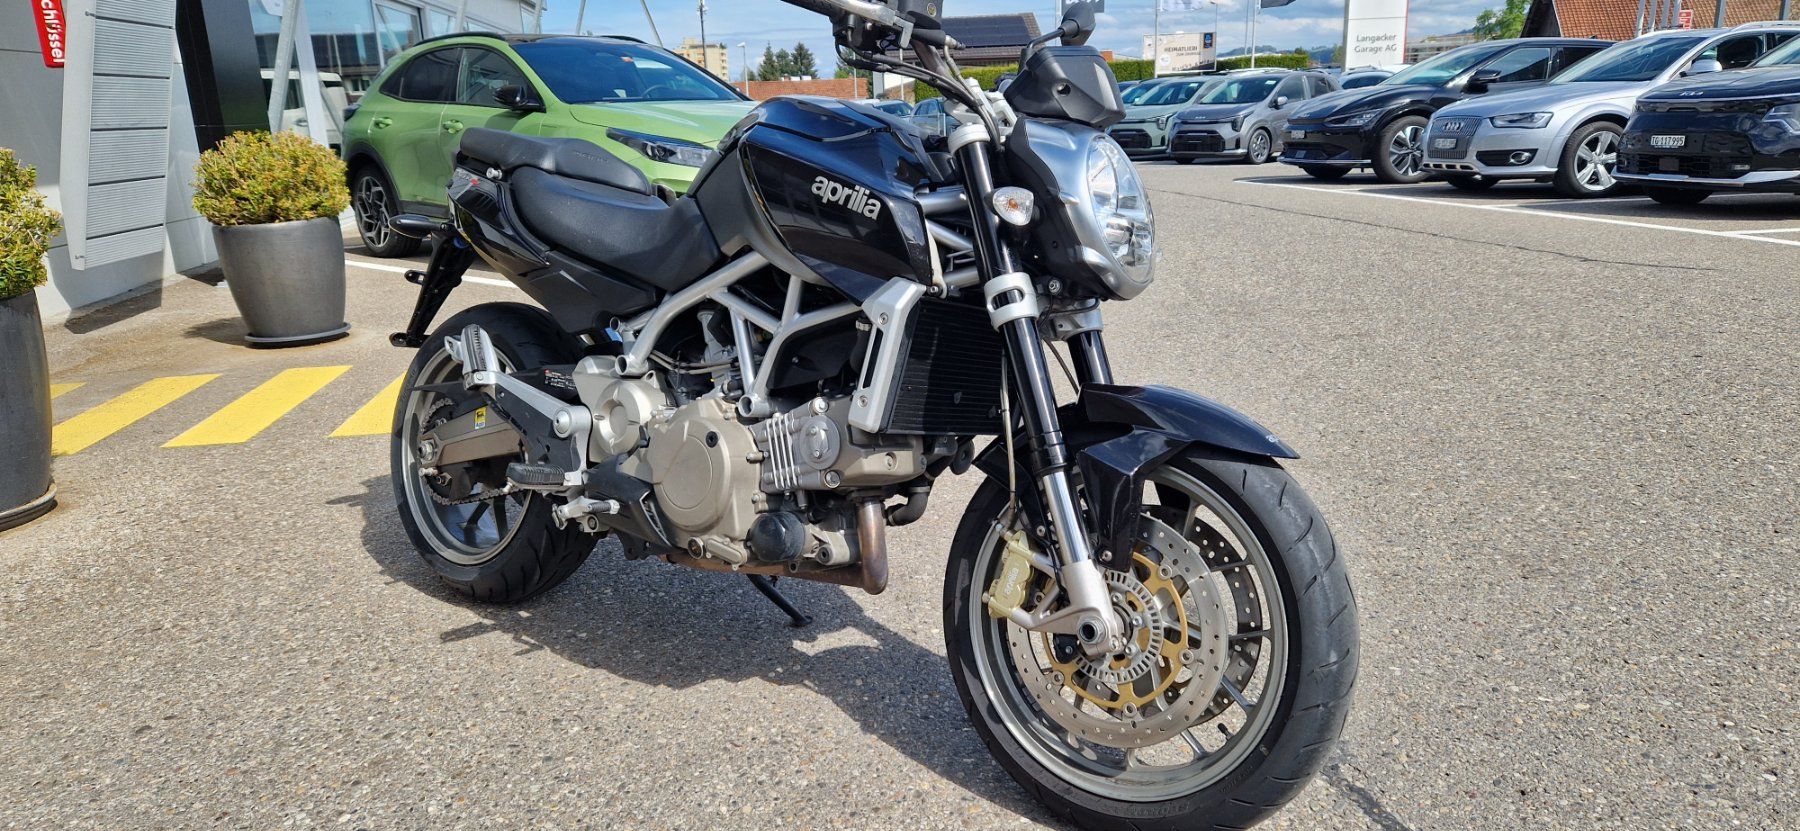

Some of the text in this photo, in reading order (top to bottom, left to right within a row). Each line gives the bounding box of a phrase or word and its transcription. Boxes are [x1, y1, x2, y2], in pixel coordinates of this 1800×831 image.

[1357, 33, 1396, 43] Langacker
[1354, 44, 1397, 54] Garage AG
[811, 175, 881, 220] aprilia
